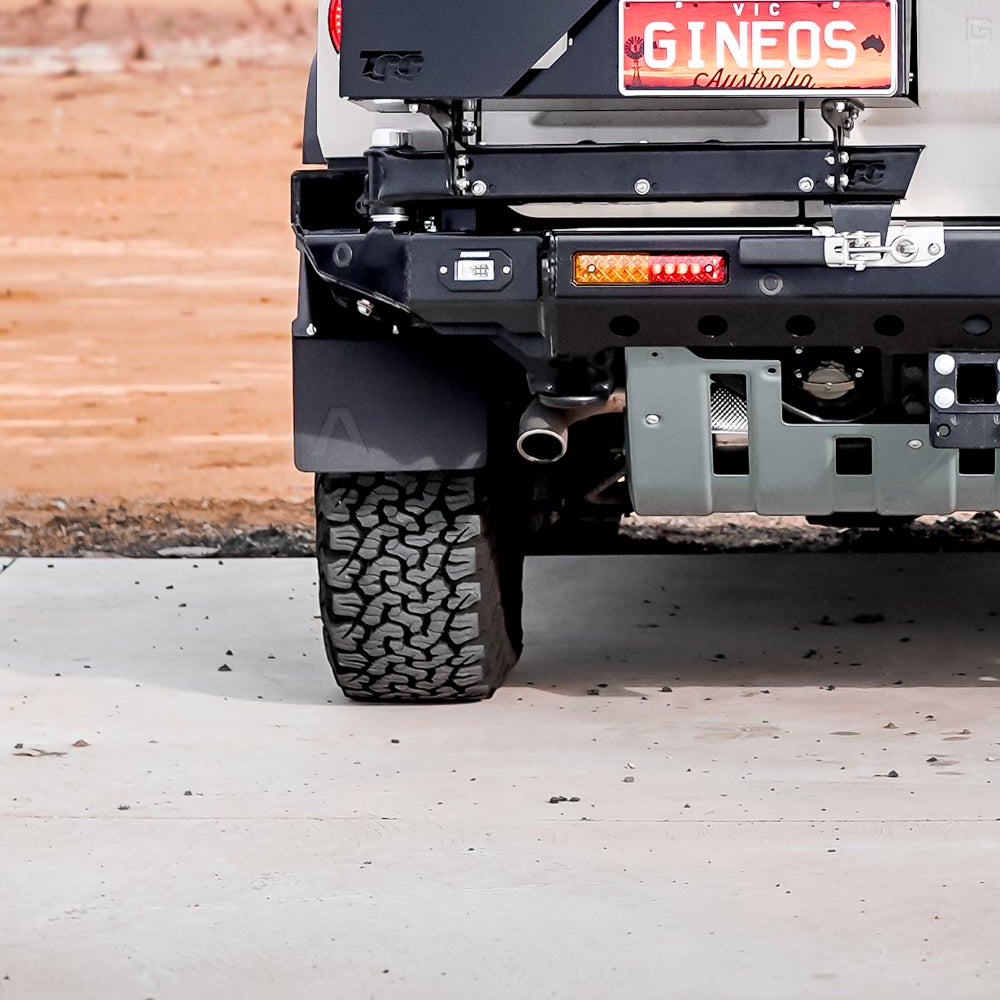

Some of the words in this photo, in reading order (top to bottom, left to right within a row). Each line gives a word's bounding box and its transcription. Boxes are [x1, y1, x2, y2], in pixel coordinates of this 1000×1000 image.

[733, 2, 780, 16] VIC
[643, 20, 857, 69] GINEOS
[693, 67, 817, 89] Australia
